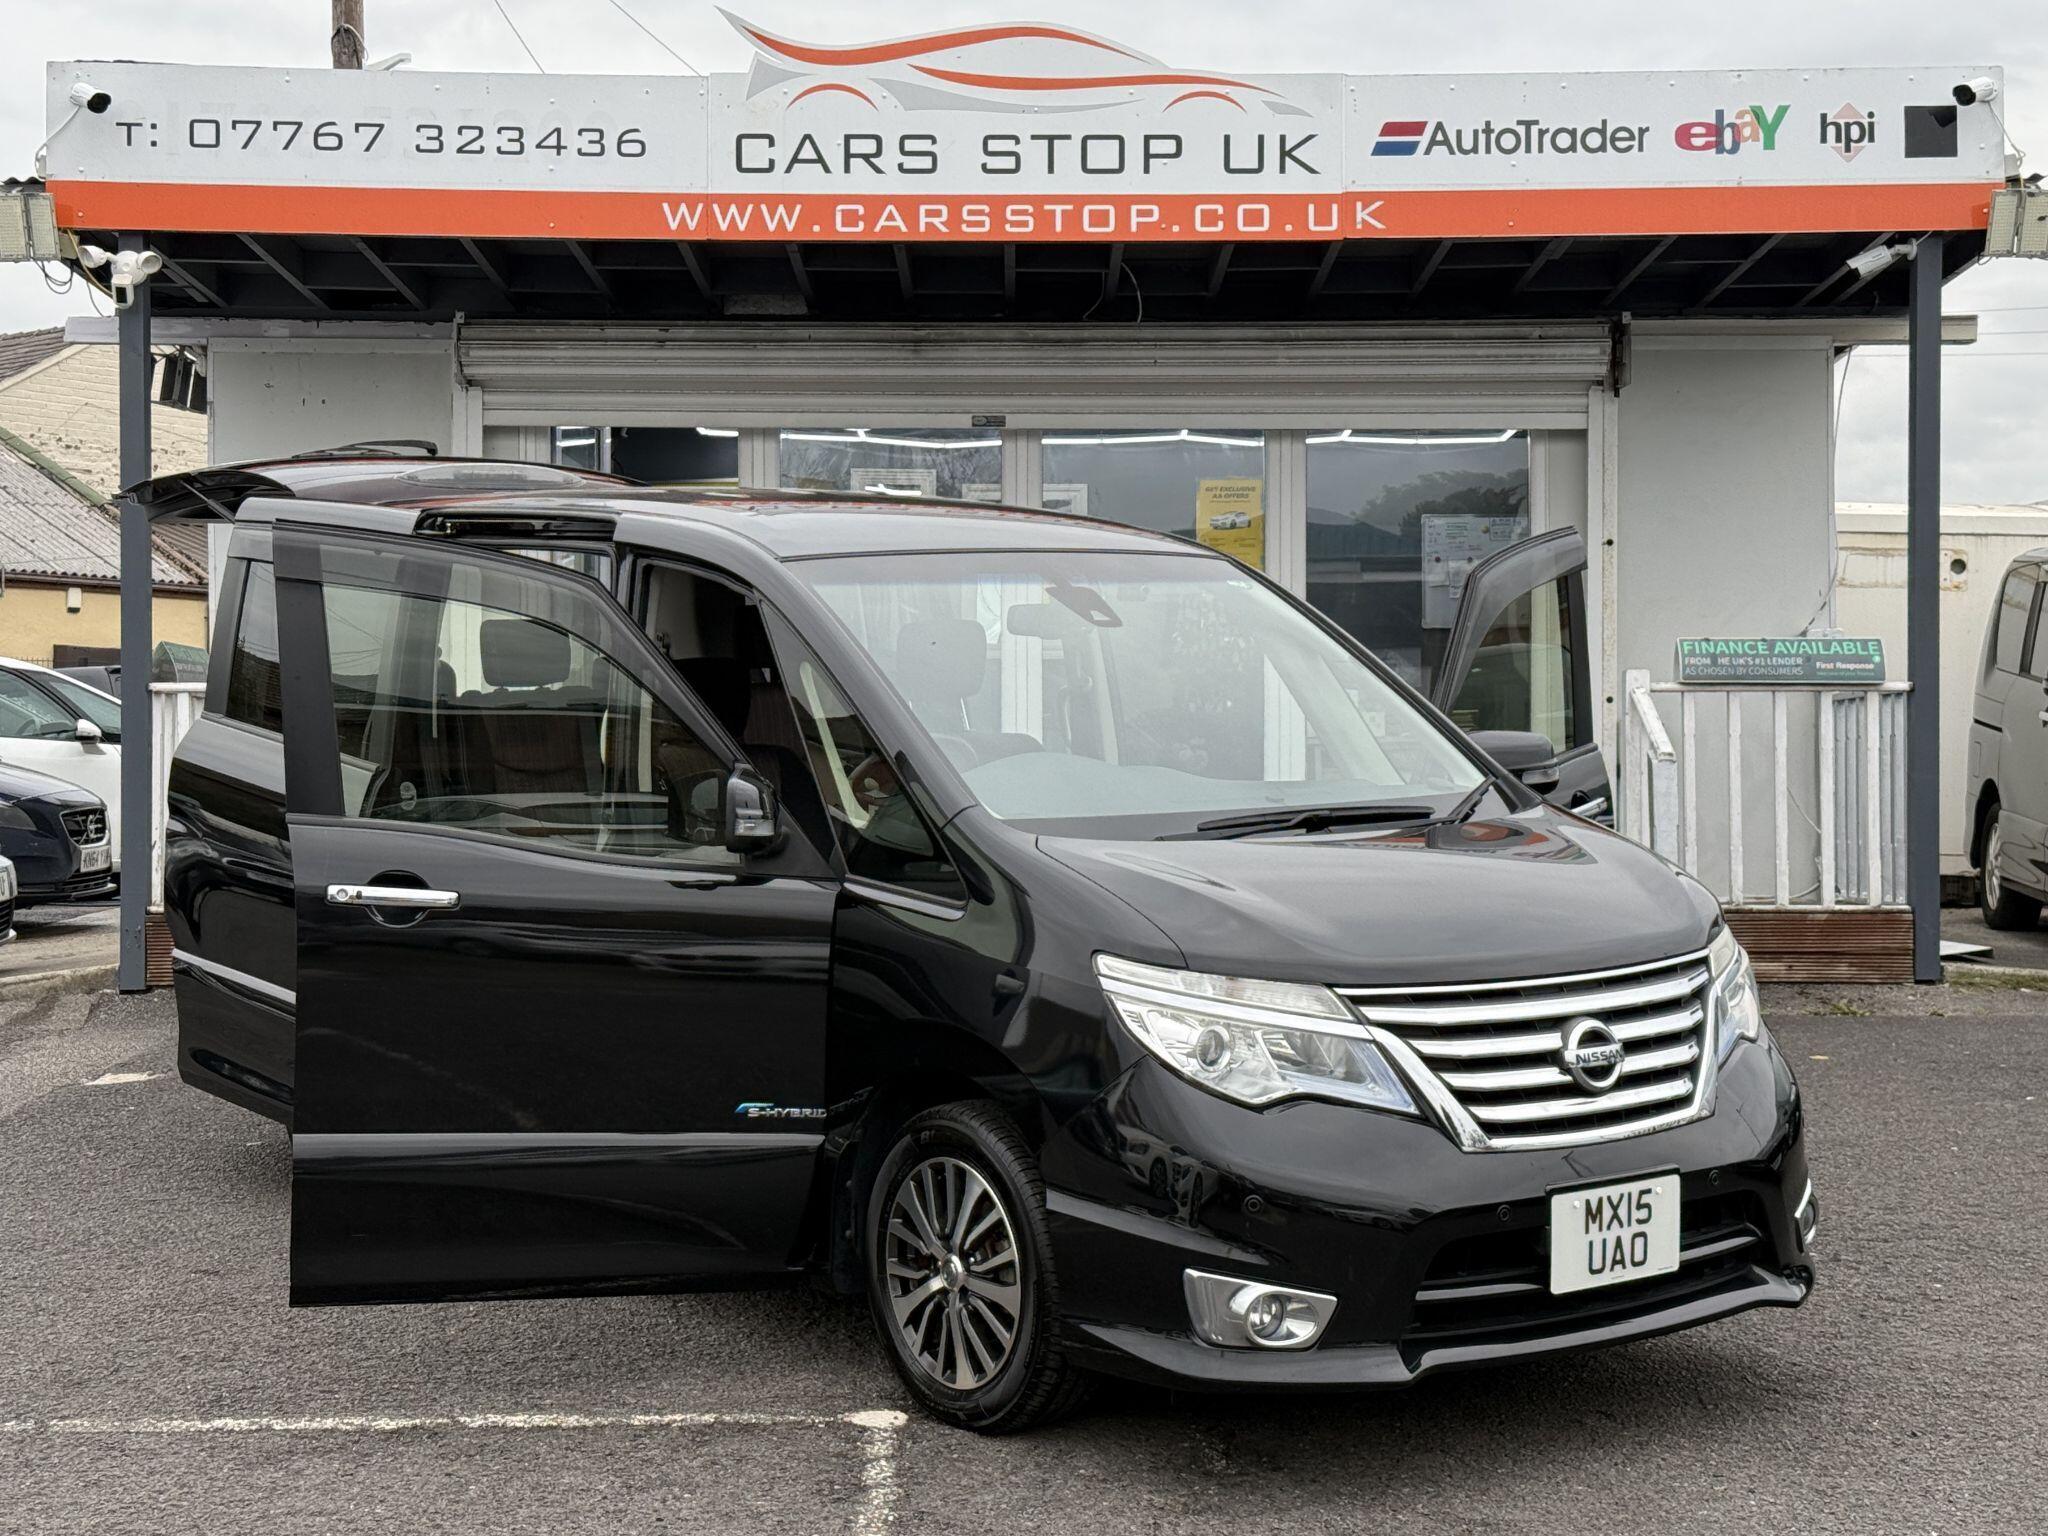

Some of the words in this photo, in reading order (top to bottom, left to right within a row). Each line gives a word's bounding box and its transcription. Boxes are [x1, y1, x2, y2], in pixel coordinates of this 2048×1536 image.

[115, 121, 158, 148] T:
[188, 118, 386, 153] 07767
[414, 124, 648, 159] 323436
[1424, 119, 1651, 156] AutoTrader
[1819, 111, 1876, 153] hpi
[735, 133, 939, 175] CARS
[980, 134, 1183, 175] STOP
[1223, 134, 1321, 175] UK
[662, 200, 1387, 237] WWW.CARSSTOP.CO.UK
[1682, 641, 1769, 655] FINANCE
[1774, 641, 1881, 655] AVAILABLE
[1685, 657, 1711, 665] FROM
[1714, 657, 1731, 665] HE
[1732, 657, 1754, 665] UK'S
[1767, 657, 1804, 665] LENDER
[1685, 667, 1697, 675] AS
[1698, 667, 1735, 675] CHOSEN
[1748, 667, 1804, 675] CONSUMERS
[1575, 1049, 1624, 1066] NISSAN
[747, 1107, 828, 1118] S-HYBRID
[1585, 1188, 1653, 1235] MX15
